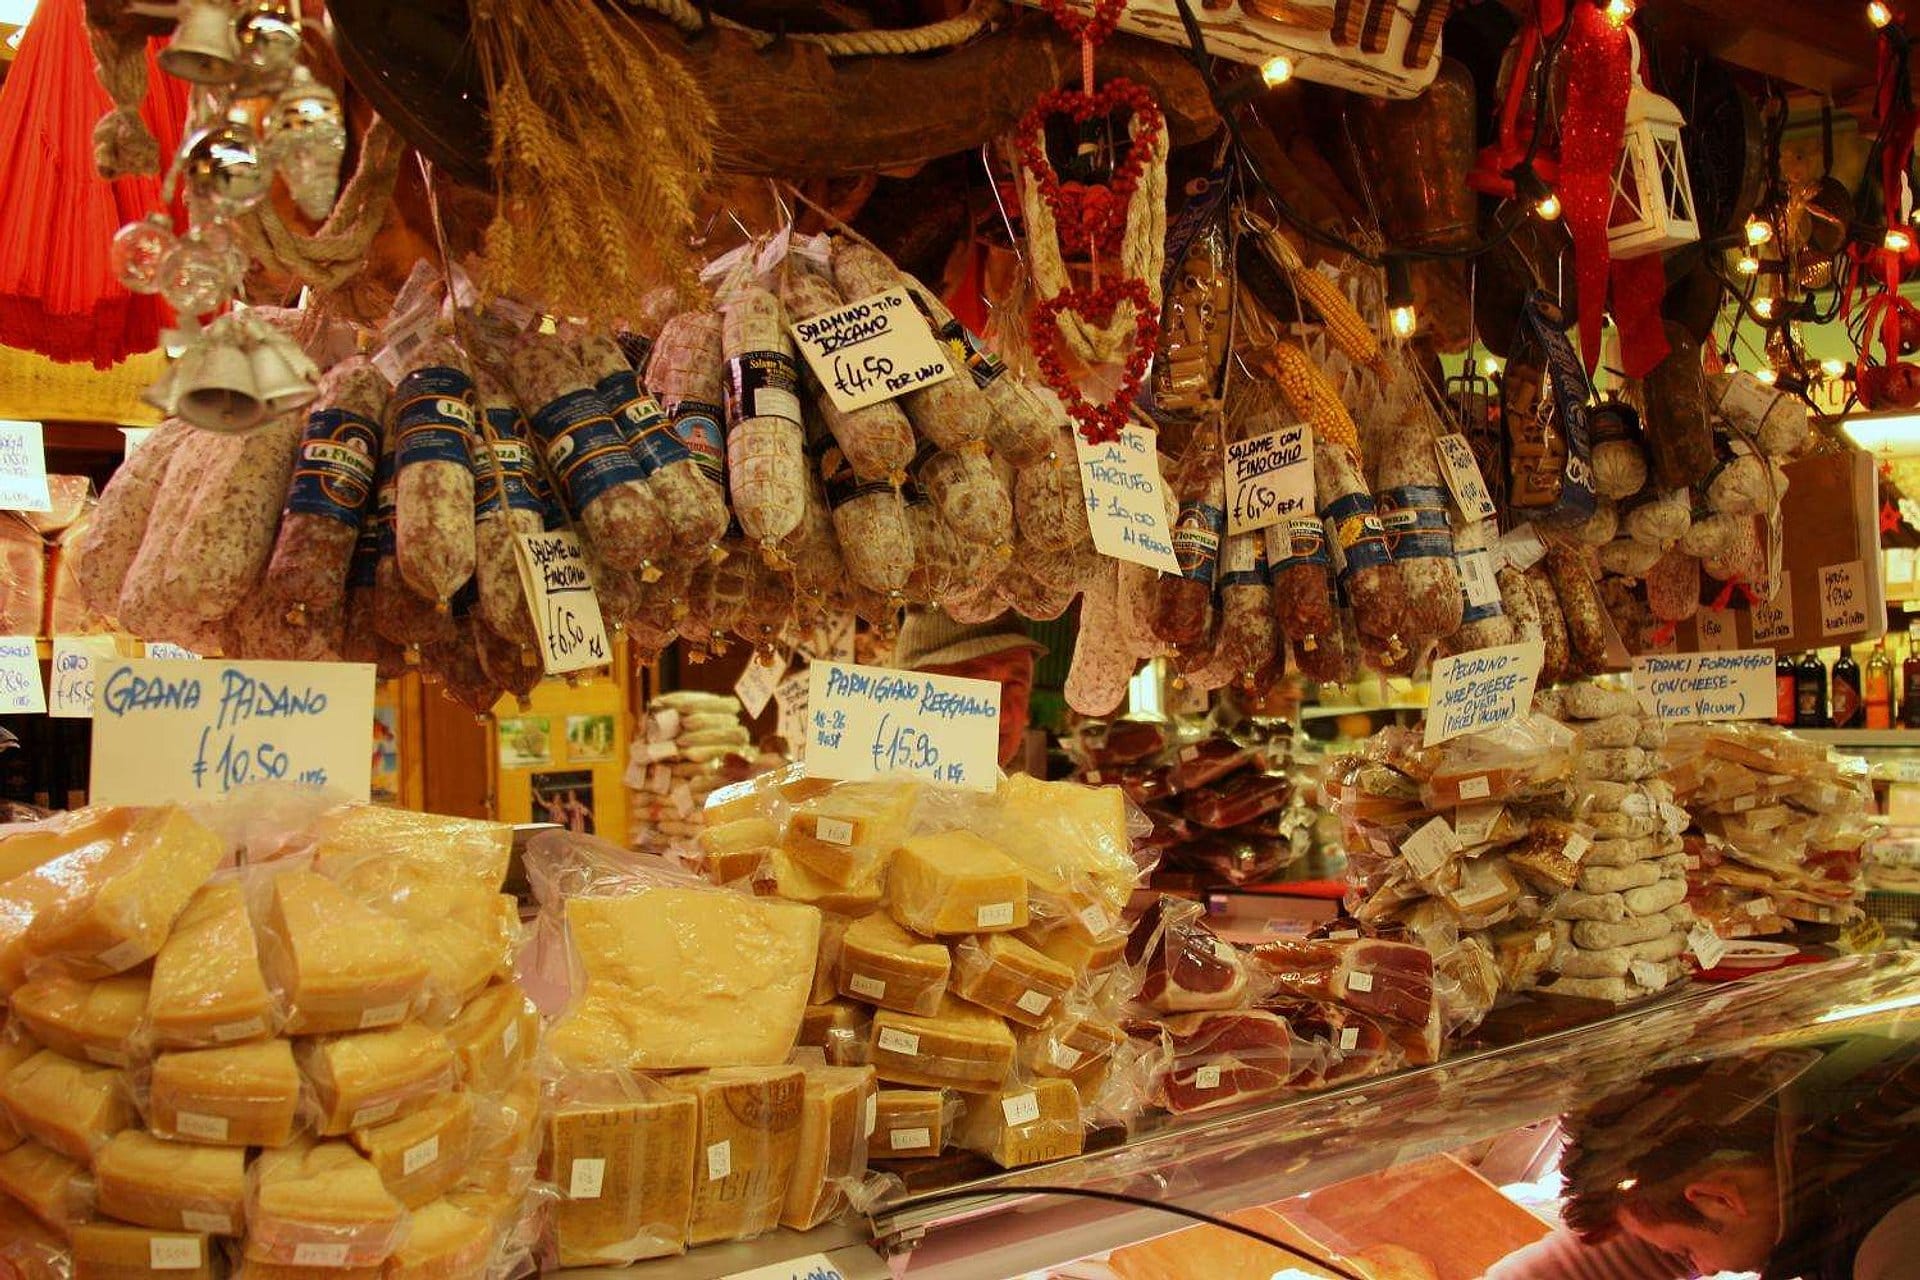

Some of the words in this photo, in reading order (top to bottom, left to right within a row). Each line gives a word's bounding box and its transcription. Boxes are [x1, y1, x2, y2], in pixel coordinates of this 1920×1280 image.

[871, 297, 902, 312] TIPO
[814, 315, 888, 354] TOSCANO
[886, 372, 914, 392] PER
[915, 364, 944, 383] UNO
[1104, 448, 1126, 463] AL
[1228, 436, 1273, 464] SALAME
[1280, 428, 1303, 447] CON
[1236, 445, 1302, 479] FINOCCHIO
[1085, 460, 1153, 494] TARTUFO
[1698, 654, 1774, 673] FORMAGGIO
[104, 667, 200, 717] GRANA
[218, 669, 328, 730] PADANO
[826, 667, 919, 704] PARMIGIANO
[919, 681, 996, 719] REGGIANO
